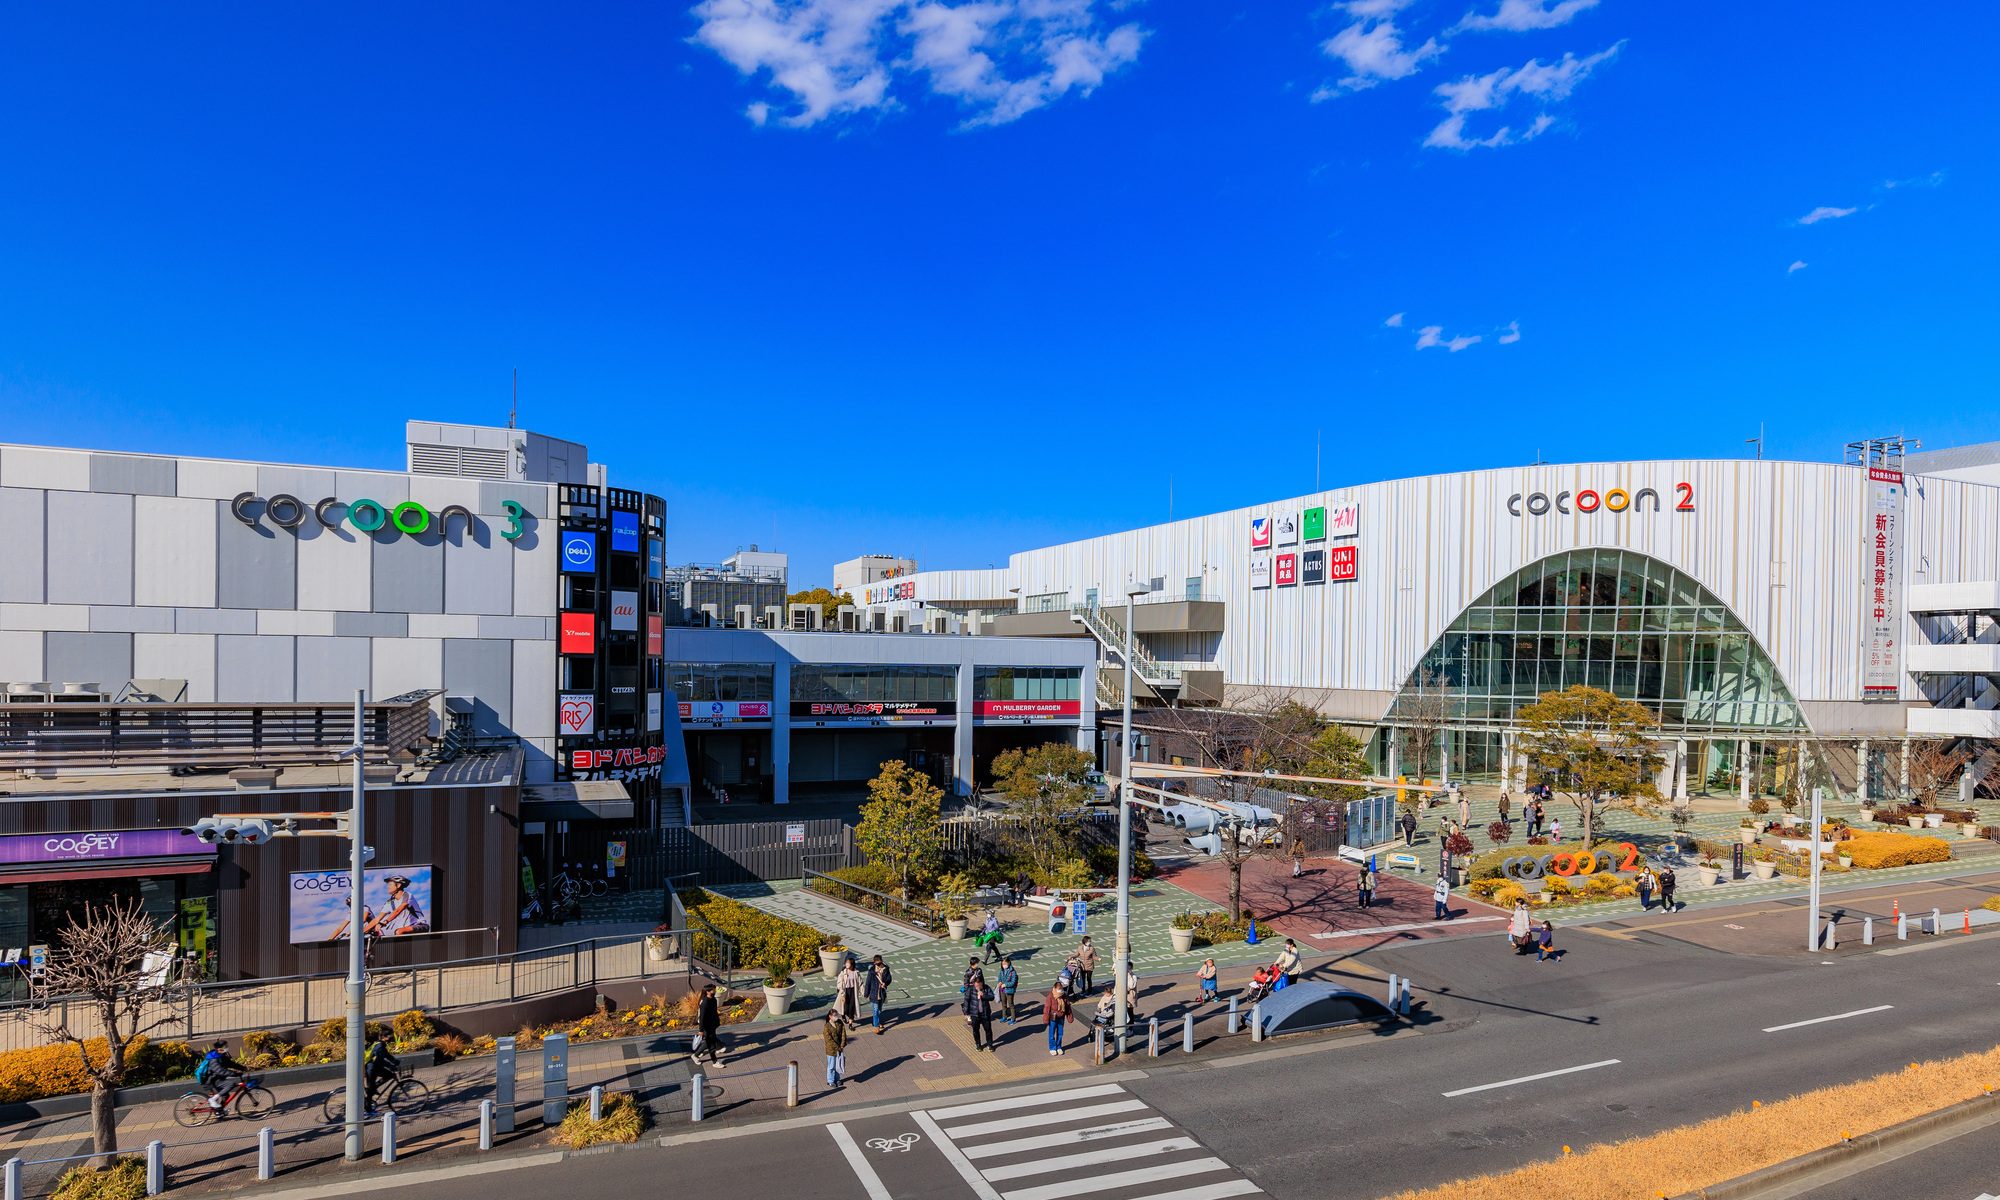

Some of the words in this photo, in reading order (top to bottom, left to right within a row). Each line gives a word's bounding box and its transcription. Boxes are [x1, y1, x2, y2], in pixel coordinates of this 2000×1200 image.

[1506, 487, 1661, 517] cocoon
[1675, 481, 1696, 513] 2
[231, 491, 474, 535] cocoon
[500, 499, 524, 540] 3
[1333, 506, 1356, 529] H&M
[568, 547, 589, 556] DELL
[1333, 550, 1353, 562] UNI
[1304, 560, 1322, 572] ACTUS
[1333, 563, 1354, 577] QLO
[1873, 513, 1888, 623] 新会員募集中
[613, 604, 635, 616] au
[811, 703, 884, 715] ヨドバシカメラ
[560, 710, 582, 725] IRIS
[44, 833, 119, 854] COGGEY
[1501, 850, 1617, 880] cocoon
[1618, 842, 1639, 871] 2
[294, 874, 353, 892] COGGEY
